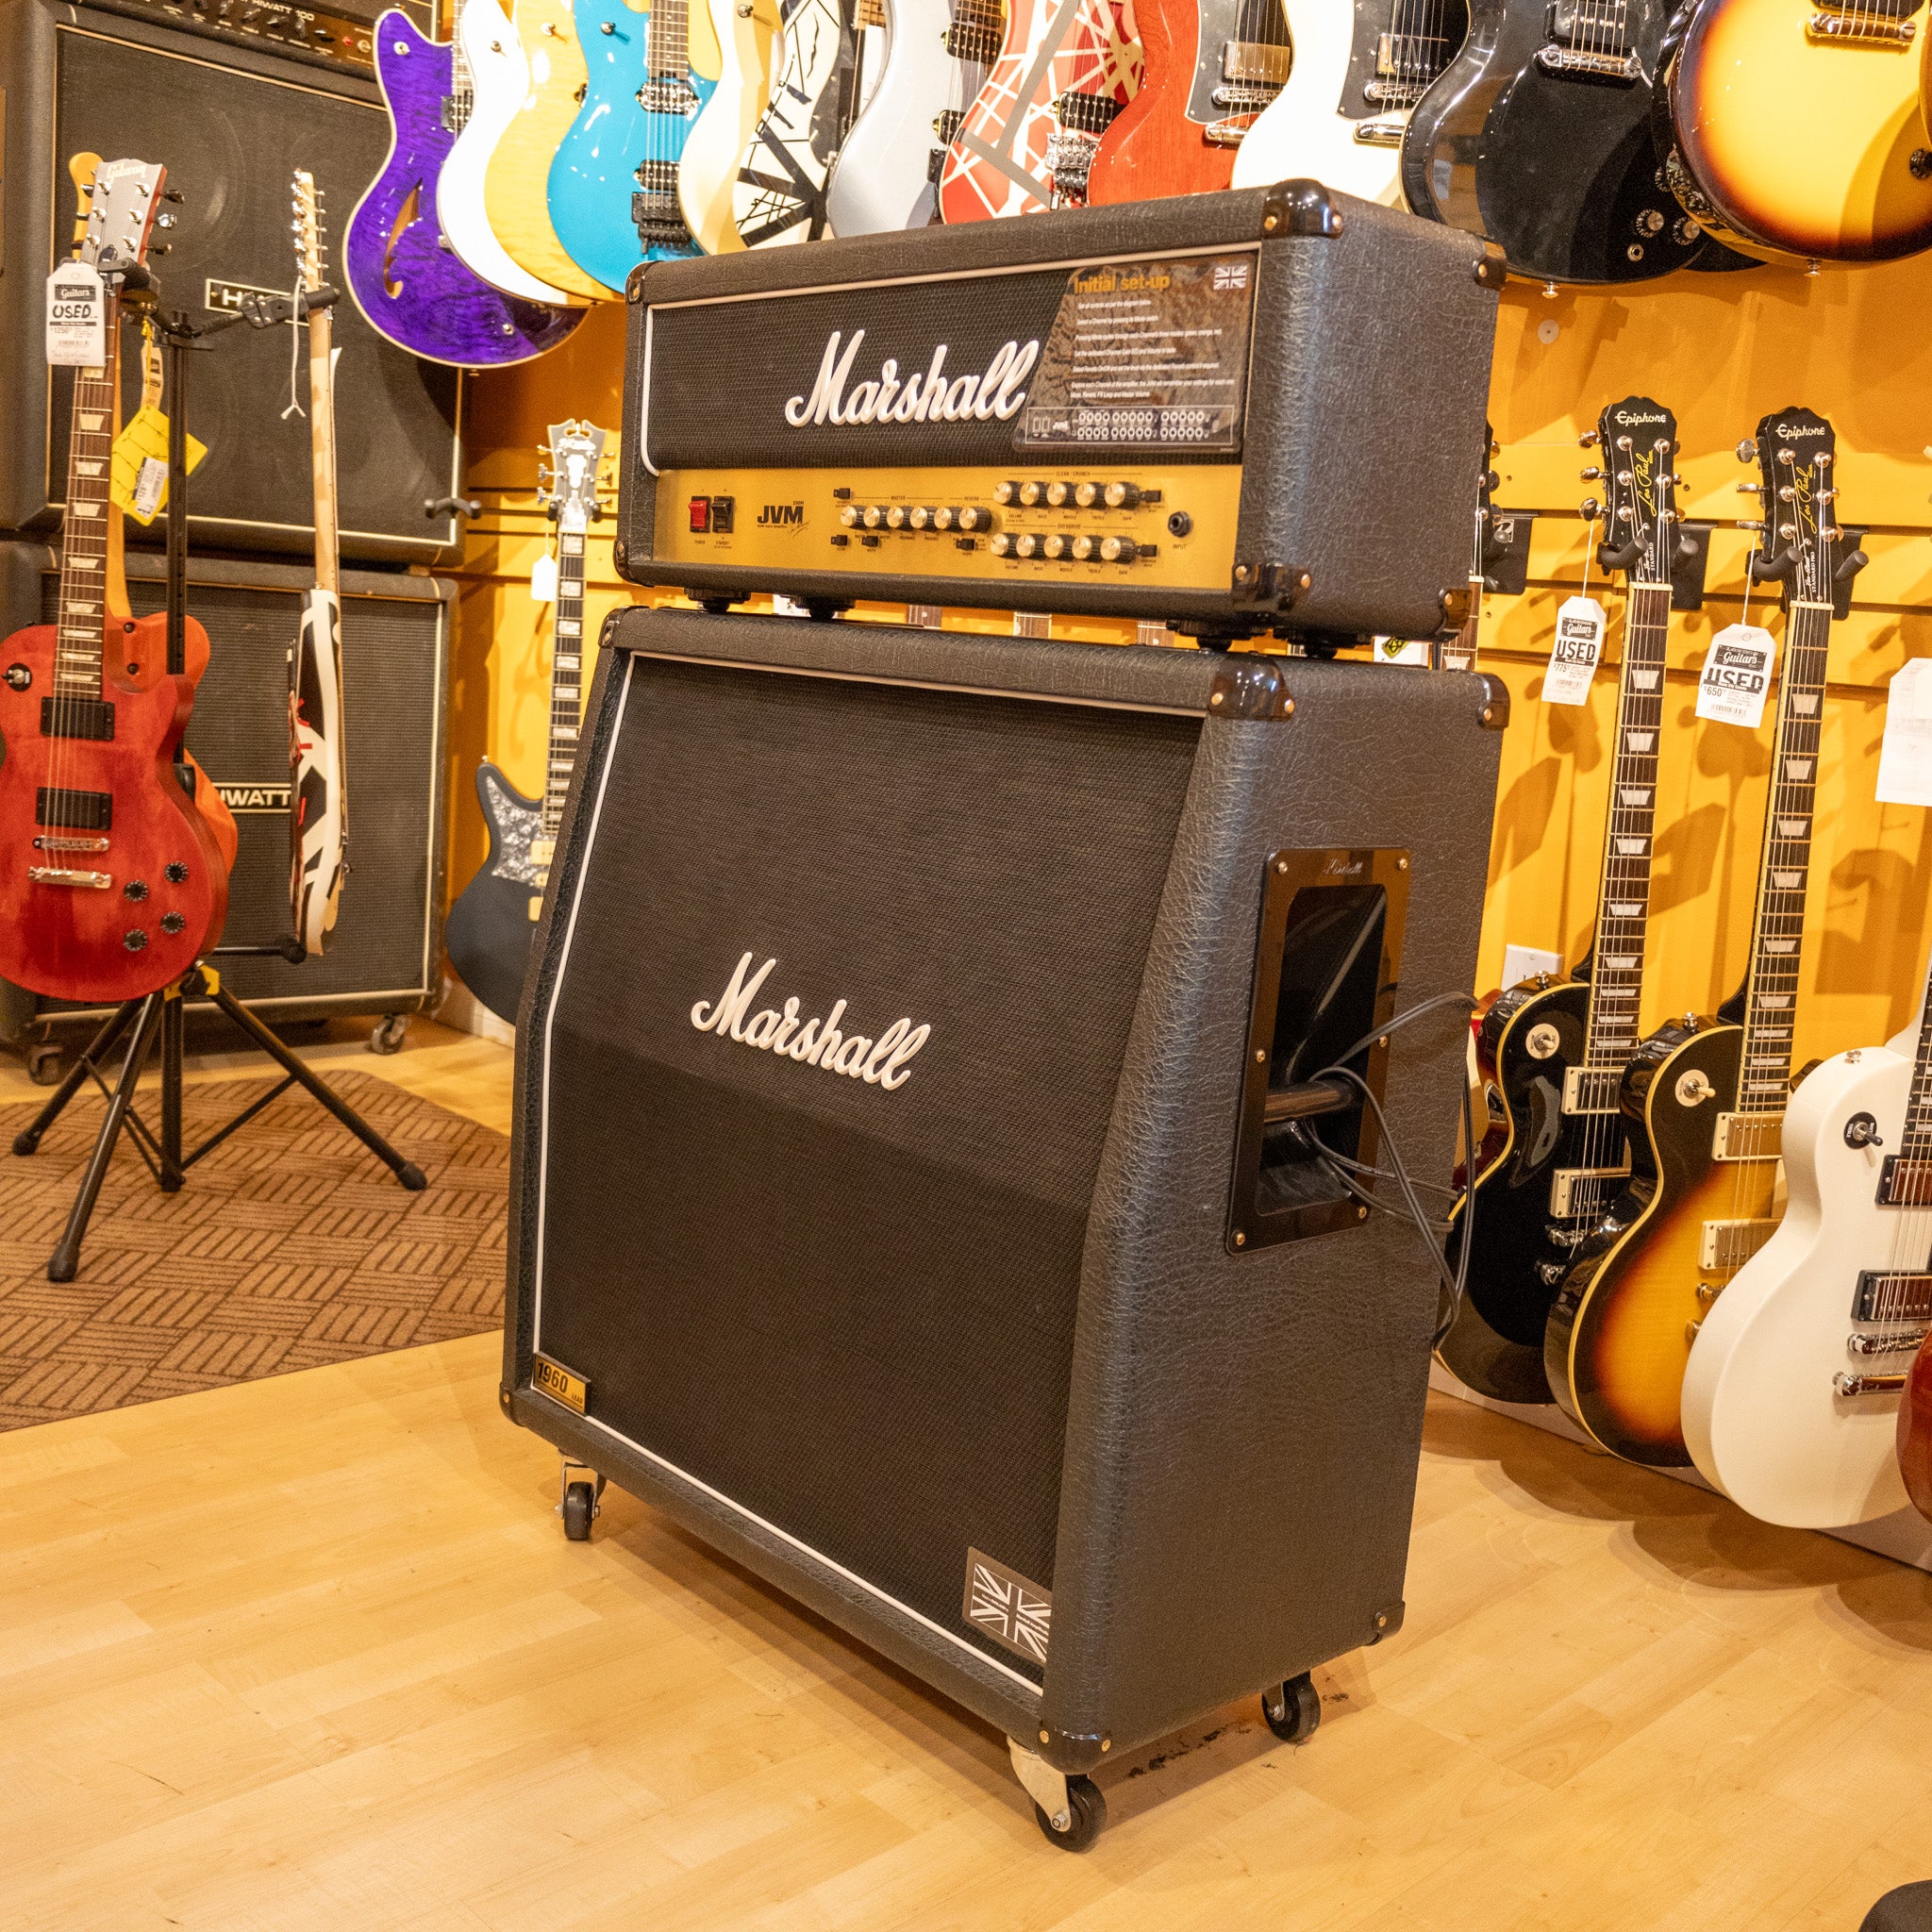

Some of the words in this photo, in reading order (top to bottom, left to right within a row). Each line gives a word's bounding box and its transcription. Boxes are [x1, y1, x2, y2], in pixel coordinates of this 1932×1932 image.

[295, 10, 315, 22] 100
[1074, 275, 1116, 294] Initial
[1121, 275, 1171, 293] set-up
[60, 289, 91, 300] Guitars
[53, 304, 92, 319] USED
[785, 329, 1039, 427] Marshall
[1614, 410, 1666, 426] Epiphone
[1775, 424, 1825, 441] Epiphone
[1635, 452, 1653, 487] Paul
[1795, 466, 1812, 503] Paul
[757, 505, 804, 525] JVM
[1567, 623, 1592, 637] Guitars
[1556, 640, 1596, 660] USED
[1723, 651, 1757, 665] Guitars
[1707, 667, 1764, 691] USED
[220, 789, 291, 807] IWATT
[691, 951, 931, 1091] Marshall
[538, 1362, 569, 1393] 1960
[571, 1392, 584, 1405] LEAD
